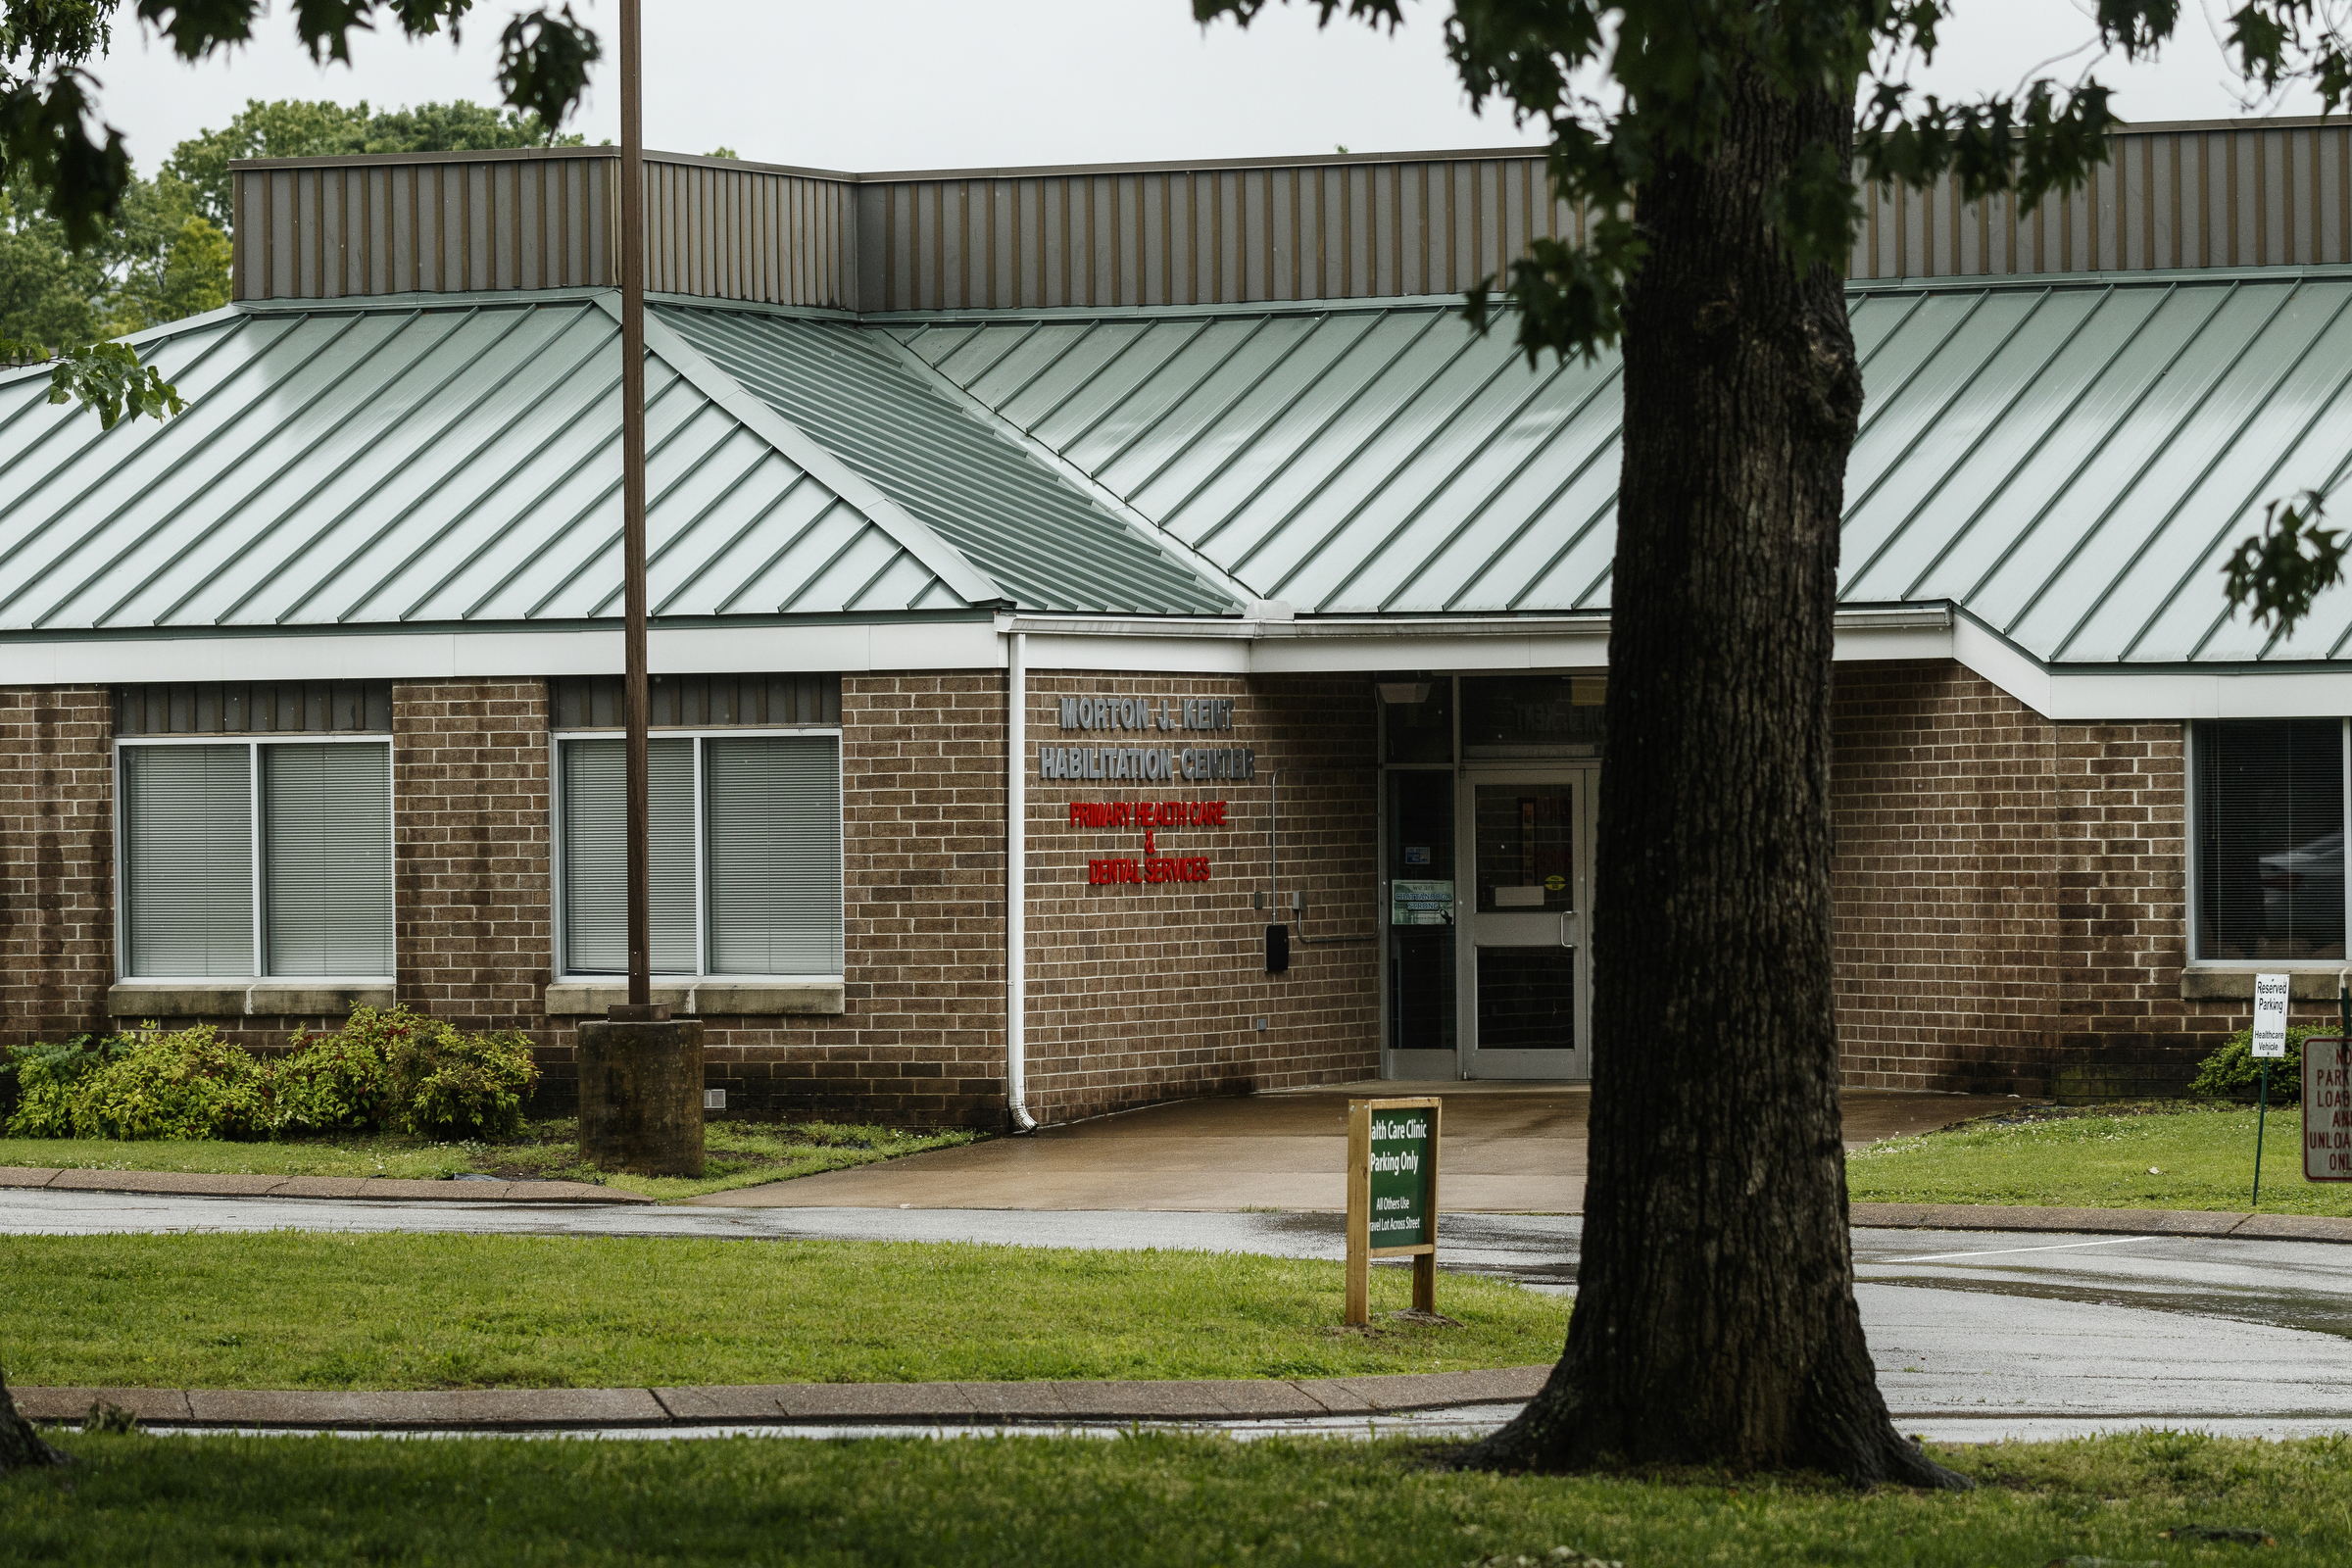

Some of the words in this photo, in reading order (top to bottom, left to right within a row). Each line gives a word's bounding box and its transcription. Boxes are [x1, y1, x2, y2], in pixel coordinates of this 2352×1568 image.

[1059, 697, 1149, 730] MORTON
[1157, 699, 1175, 731] J.
[1183, 698, 1235, 730] KENT
[1040, 748, 1173, 779] HABILITATION
[1180, 748, 1255, 780] CENTER
[1070, 802, 1131, 827] PRIMARY
[1135, 802, 1187, 826] HEALTH
[1190, 801, 1227, 826] CARE
[1145, 829, 1156, 855] &
[1089, 858, 1142, 884] DENTAL
[1144, 857, 1211, 883] SERVICES
[2257, 981, 2287, 995] Reserved
[2259, 998, 2283, 1013] Parking
[2255, 1030, 2283, 1040] Healthcare
[2259, 1042, 2278, 1051] Vehicle
[2317, 1069, 2352, 1086] PARK
[2332, 1110, 2352, 1127] AN
[1371, 1119, 1387, 1140] alth
[1388, 1120, 1405, 1140] Care
[1406, 1118, 1427, 1139] Clinic
[1370, 1151, 1399, 1176] Parking
[1400, 1150, 1419, 1175] Only
[1383, 1196, 1400, 1210] Others
[1400, 1196, 1409, 1209] Use
[1369, 1217, 1381, 1232] ravel
[1381, 1218, 1390, 1231] Lot
[1390, 1217, 1405, 1230] Across
[1405, 1215, 1420, 1229] Street
